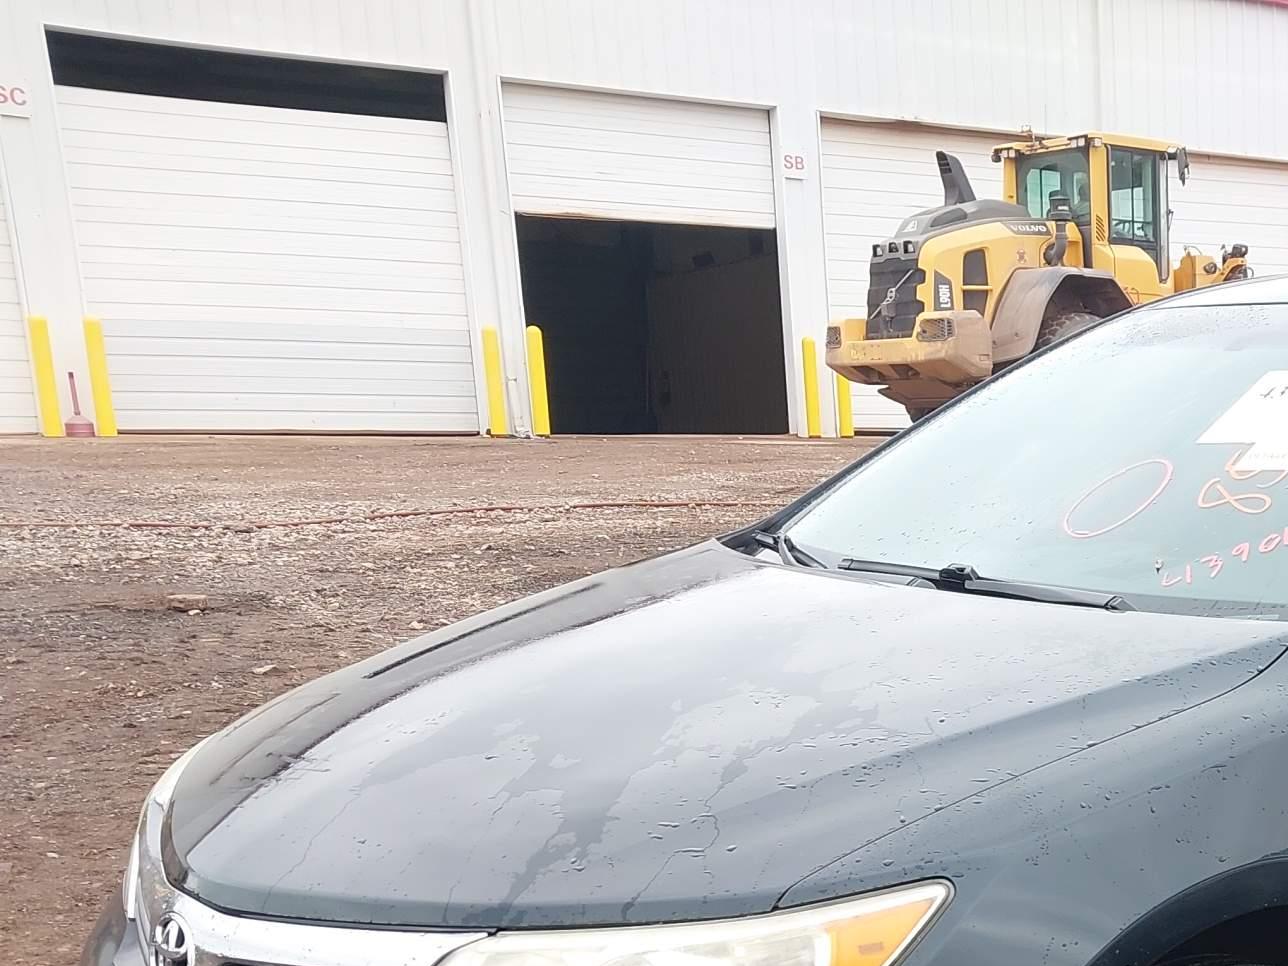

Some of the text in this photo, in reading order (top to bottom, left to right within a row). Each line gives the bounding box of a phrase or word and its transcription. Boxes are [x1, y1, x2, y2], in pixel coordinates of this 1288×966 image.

[784, 154, 804, 170] SB
[1010, 224, 1047, 232] VOLVO
[938, 284, 951, 308] L90H
